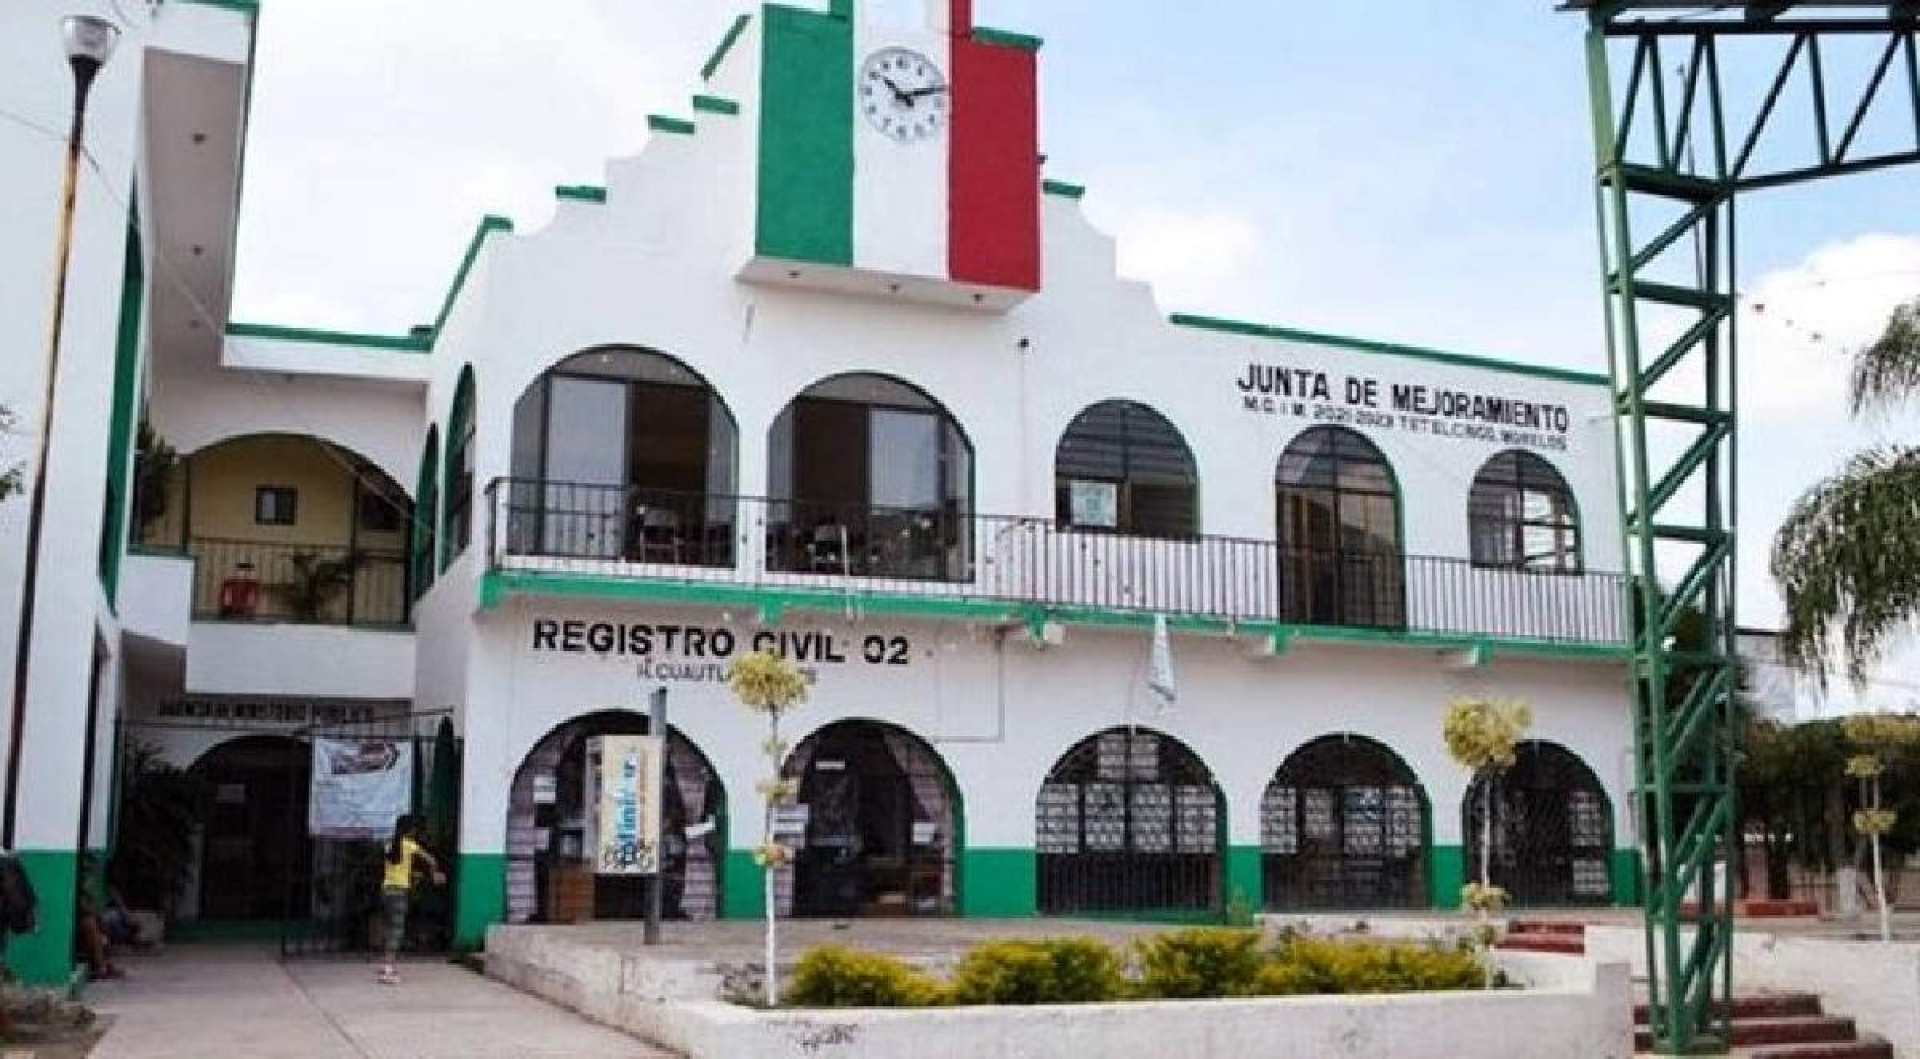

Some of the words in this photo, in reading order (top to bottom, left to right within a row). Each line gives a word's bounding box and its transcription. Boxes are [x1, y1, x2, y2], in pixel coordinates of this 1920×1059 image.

[1237, 363, 1331, 401] JUNTA
[1345, 376, 1378, 409] DE
[1391, 383, 1569, 433] MEJORAMIENTO
[532, 619, 736, 658] REGISTRO
[752, 630, 846, 664] CIVIL
[863, 634, 910, 666] 02
